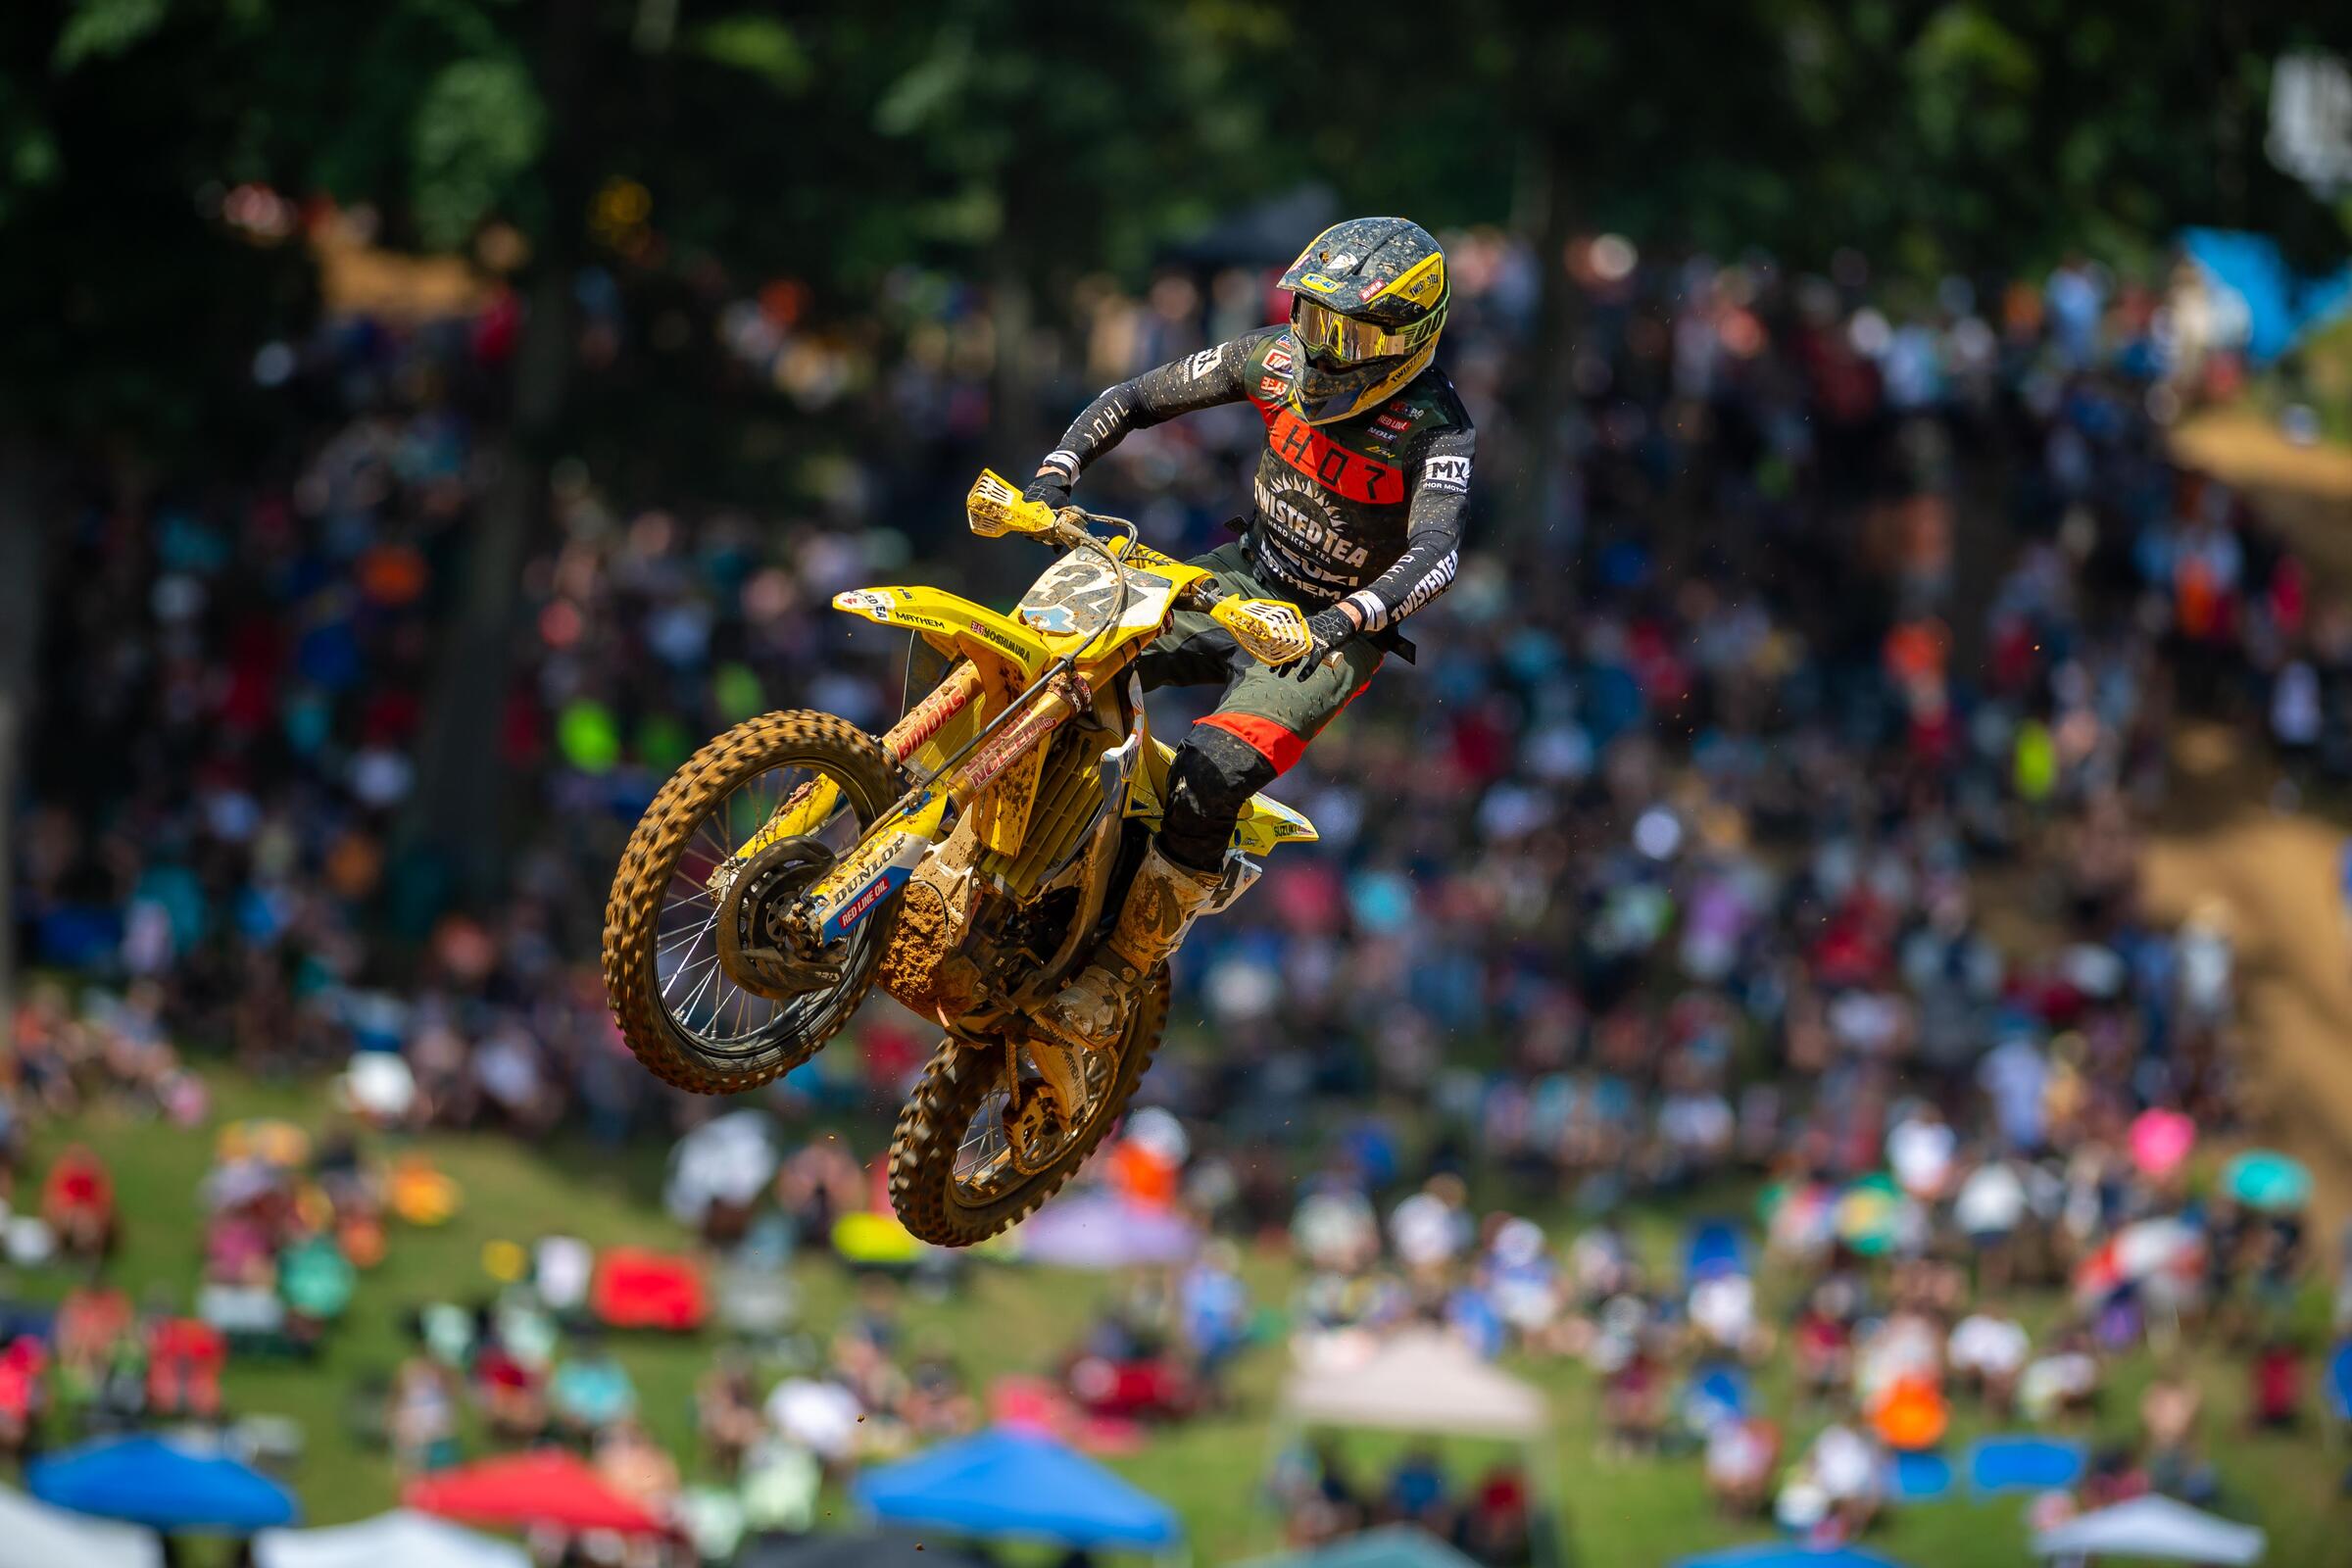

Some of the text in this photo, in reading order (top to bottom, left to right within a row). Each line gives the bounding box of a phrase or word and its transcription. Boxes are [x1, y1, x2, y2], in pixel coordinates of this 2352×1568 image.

[1268, 355, 1293, 373] 100
[1378, 415, 1393, 426] RED
[1432, 461, 1466, 480] MX
[1253, 475, 1369, 568] TWISTED TEA
[1267, 518, 1332, 564] HARD ICED TEA
[1391, 567, 1446, 622] TWISTED
[895, 611, 946, 629] MAYHEM
[983, 627, 1031, 663] YOSHIMURA
[970, 720, 1040, 789] NOLEEN
[833, 832, 906, 906] DUNLOP
[842, 879, 888, 927] RED LINE OIL
